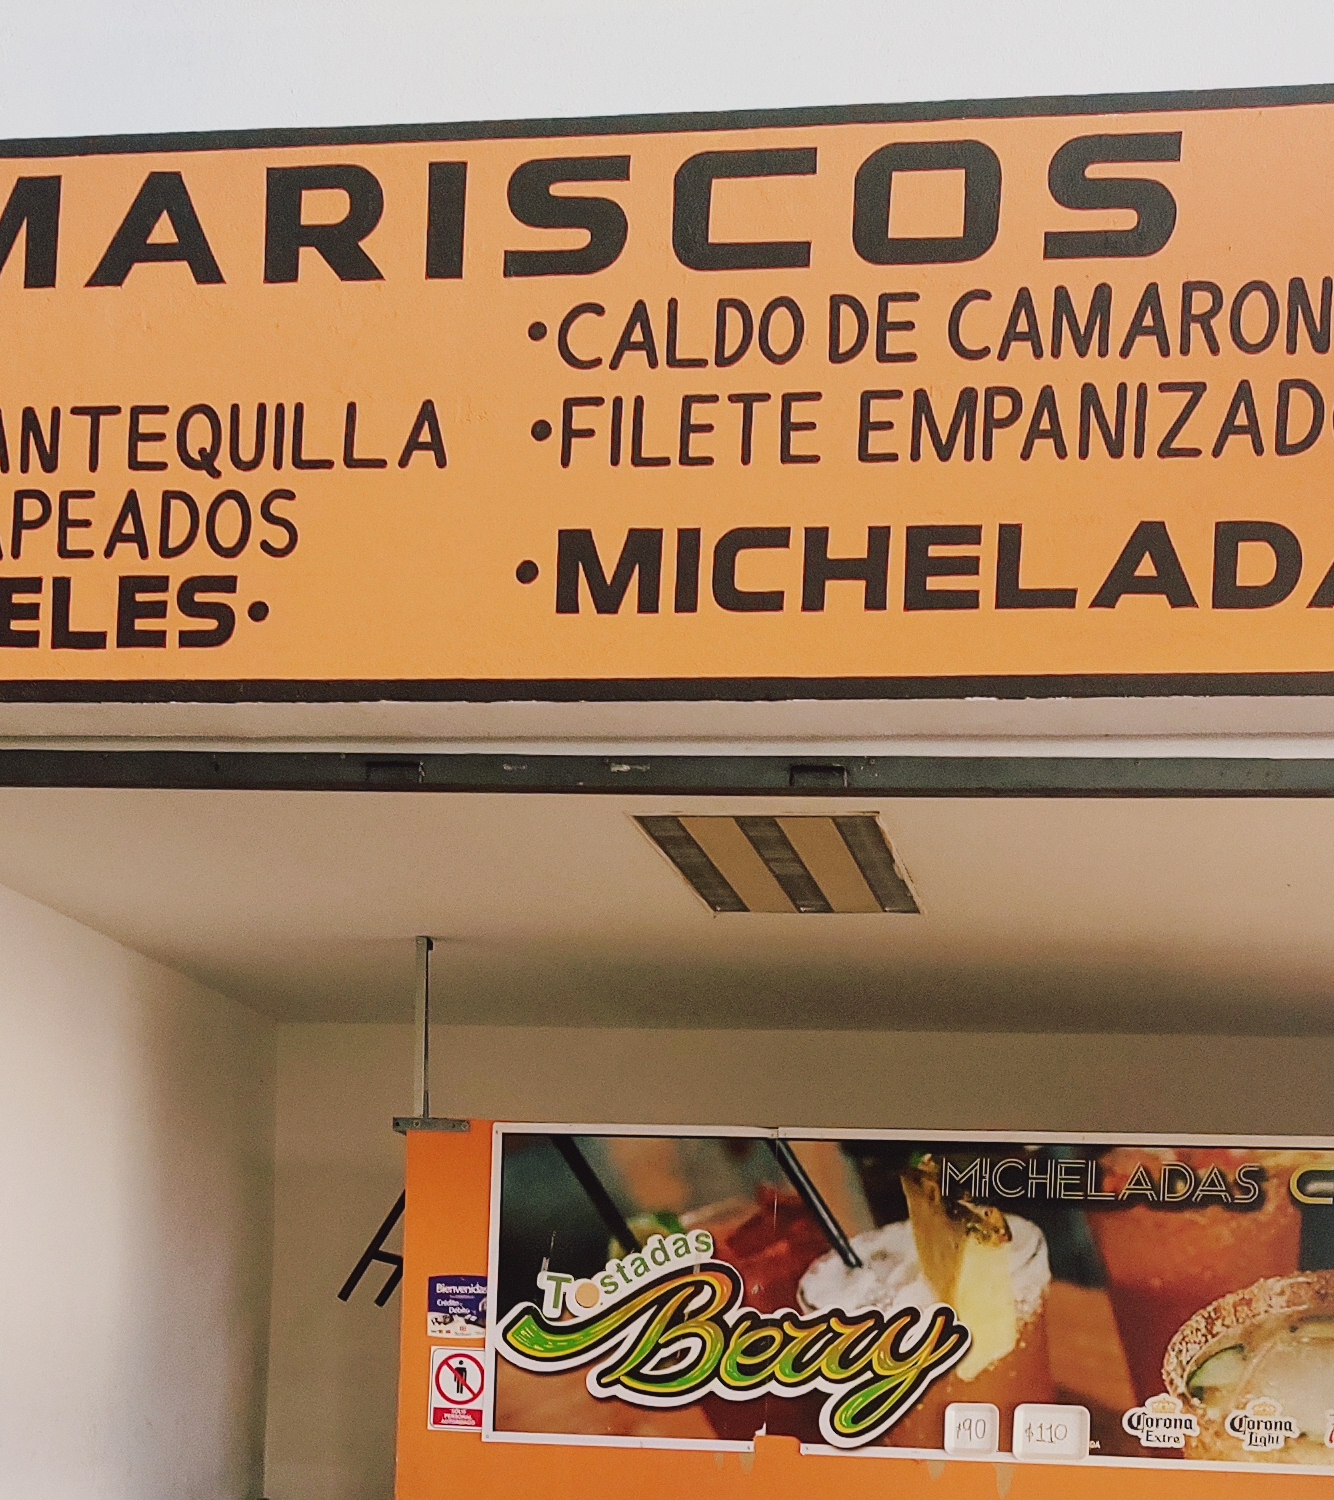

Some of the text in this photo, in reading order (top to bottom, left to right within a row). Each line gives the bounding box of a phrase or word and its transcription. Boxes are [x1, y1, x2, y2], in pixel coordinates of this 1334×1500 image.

[558, 297, 804, 370] CALDO
[829, 292, 920, 363] DE
[948, 277, 1333, 361] CAMARON
[561, 392, 822, 468] FILETE
[938, 1156, 1260, 1204] MICHELADAS
[502, 1261, 965, 1438] Berry
[1127, 1412, 1194, 1433] Corona
[1229, 1412, 1293, 1434] Corona
[1248, 1433, 1280, 1447] Light
